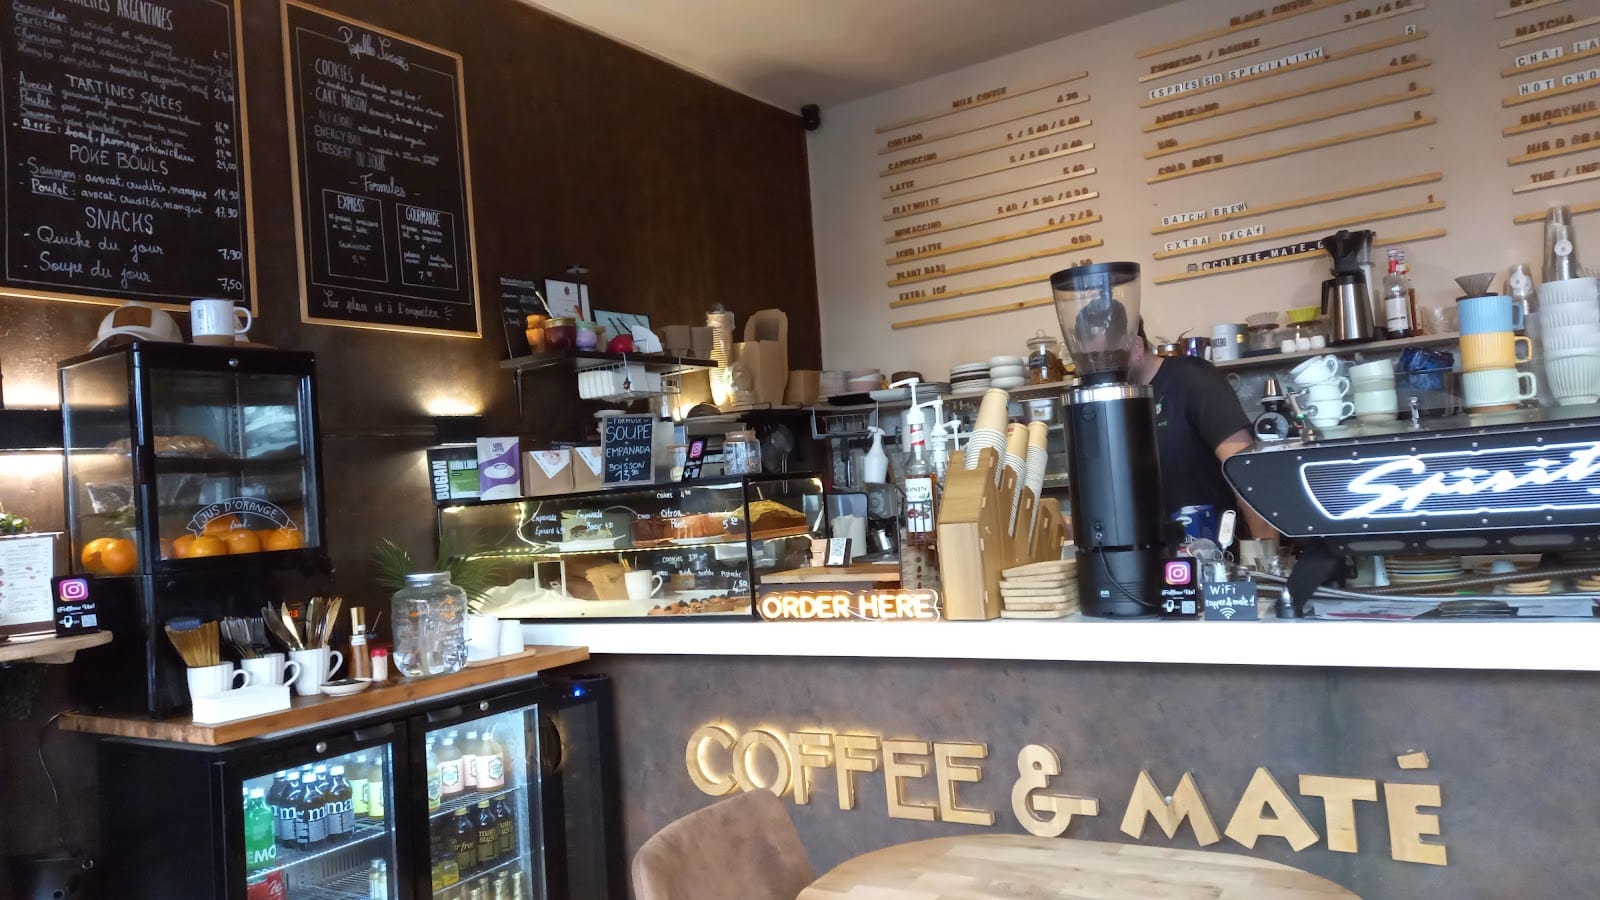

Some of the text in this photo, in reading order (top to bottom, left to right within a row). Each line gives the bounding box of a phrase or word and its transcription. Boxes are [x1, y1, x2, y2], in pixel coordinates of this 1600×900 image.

[117, 0, 174, 31] ARGENTINES
[1515, 14, 1575, 37] MATCHA
[1229, 49, 1321, 80] SPECIALITY
[1517, 41, 1600, 66] CHAI LA
[314, 57, 354, 84] COOKIES
[64, 73, 135, 99] TARTINES
[140, 91, 182, 113] SALÉES
[1521, 79, 1553, 95] HOT
[69, 143, 110, 166] POKE
[117, 152, 169, 176] BOWLS
[890, 180, 914, 192] LATTE
[85, 206, 154, 235] SNACKS
[1163, 202, 1246, 225] BATCH BREW
[37, 225, 91, 249] Quiche
[98, 236, 120, 251] du
[130, 240, 165, 263] jour
[1166, 238, 1208, 252] EXTRA
[39, 250, 84, 279] Soupe
[90, 260, 113, 279] du
[120, 269, 152, 289] jour
[605, 424, 653, 443] SOUPE
[606, 446, 651, 458] EMPANADA
[608, 461, 646, 472] BOISSON
[431, 460, 450, 500] BUGAN
[1341, 441, 1600, 520] Spirit
[198, 500, 279, 524] JUS D'ORANGE
[1209, 583, 1236, 595] WiFi
[761, 594, 934, 620] ORDER HERE
[685, 722, 1448, 867] COFFEE & MATÉ
